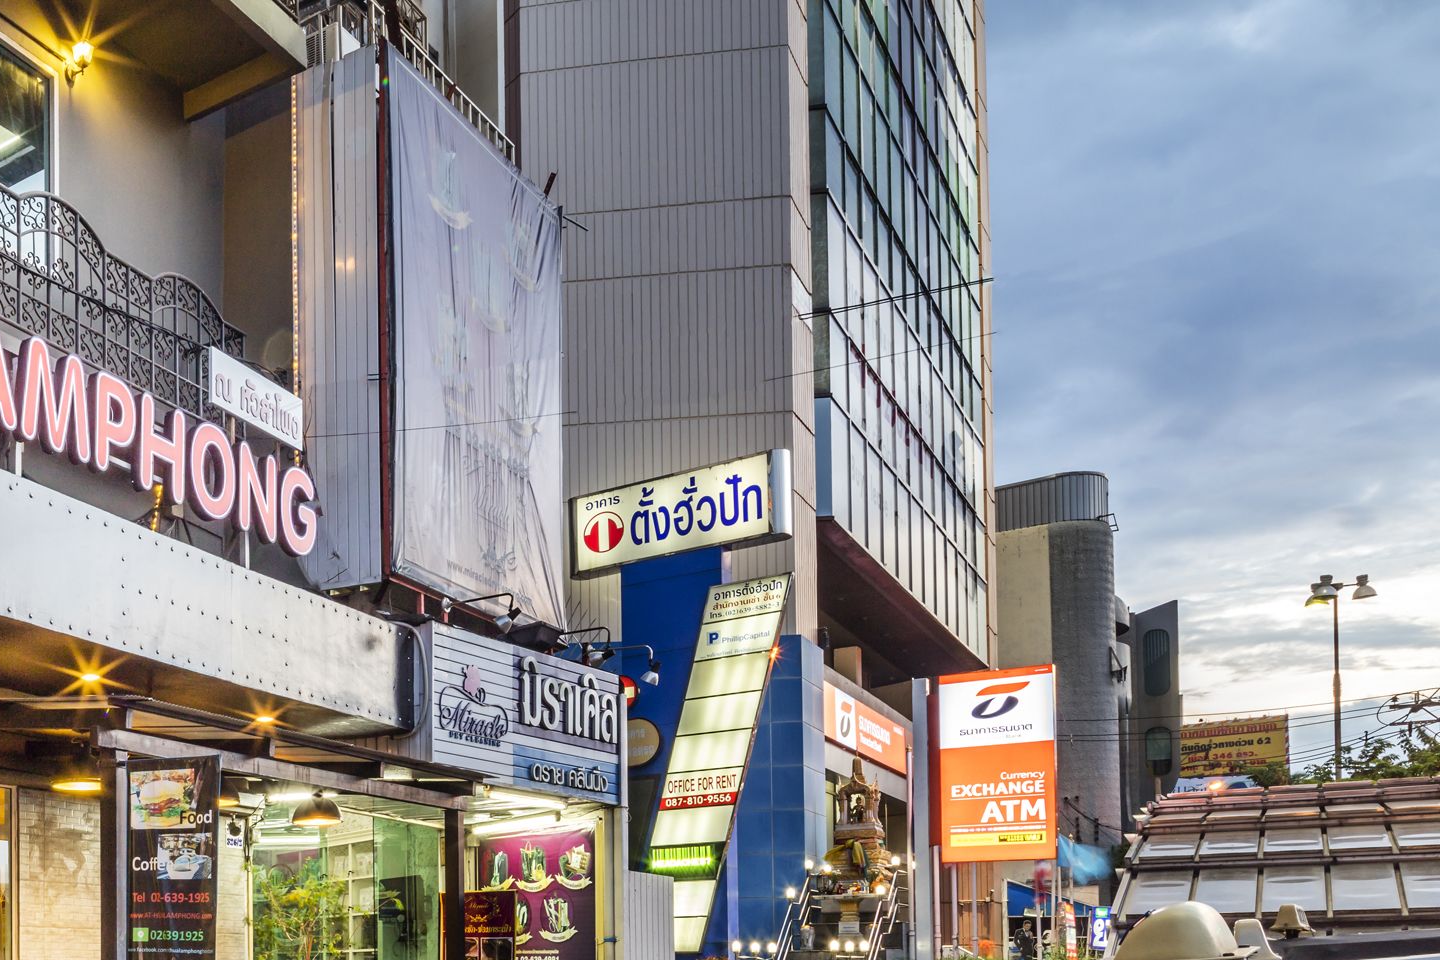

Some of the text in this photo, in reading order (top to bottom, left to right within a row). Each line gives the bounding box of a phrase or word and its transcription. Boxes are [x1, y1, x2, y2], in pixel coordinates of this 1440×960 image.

[585, 494, 620, 511] อาคาร
[630, 473, 763, 546] ตั้งฮั่วปัก
[520, 655, 618, 744] มิราเคิล
[441, 701, 506, 738] Miracle
[465, 734, 501, 747] CLEANING
[531, 762, 564, 785] ดราย
[1000, 771, 1045, 780] Currency
[668, 774, 737, 793] OFFICE FOR RENT
[951, 780, 1045, 798] EXCHANGE
[665, 794, 731, 807] 087-810-9556
[179, 809, 213, 825] Food
[980, 798, 1047, 824] ATM
[132, 856, 170, 872] Coffe
[132, 892, 145, 903] Tel
